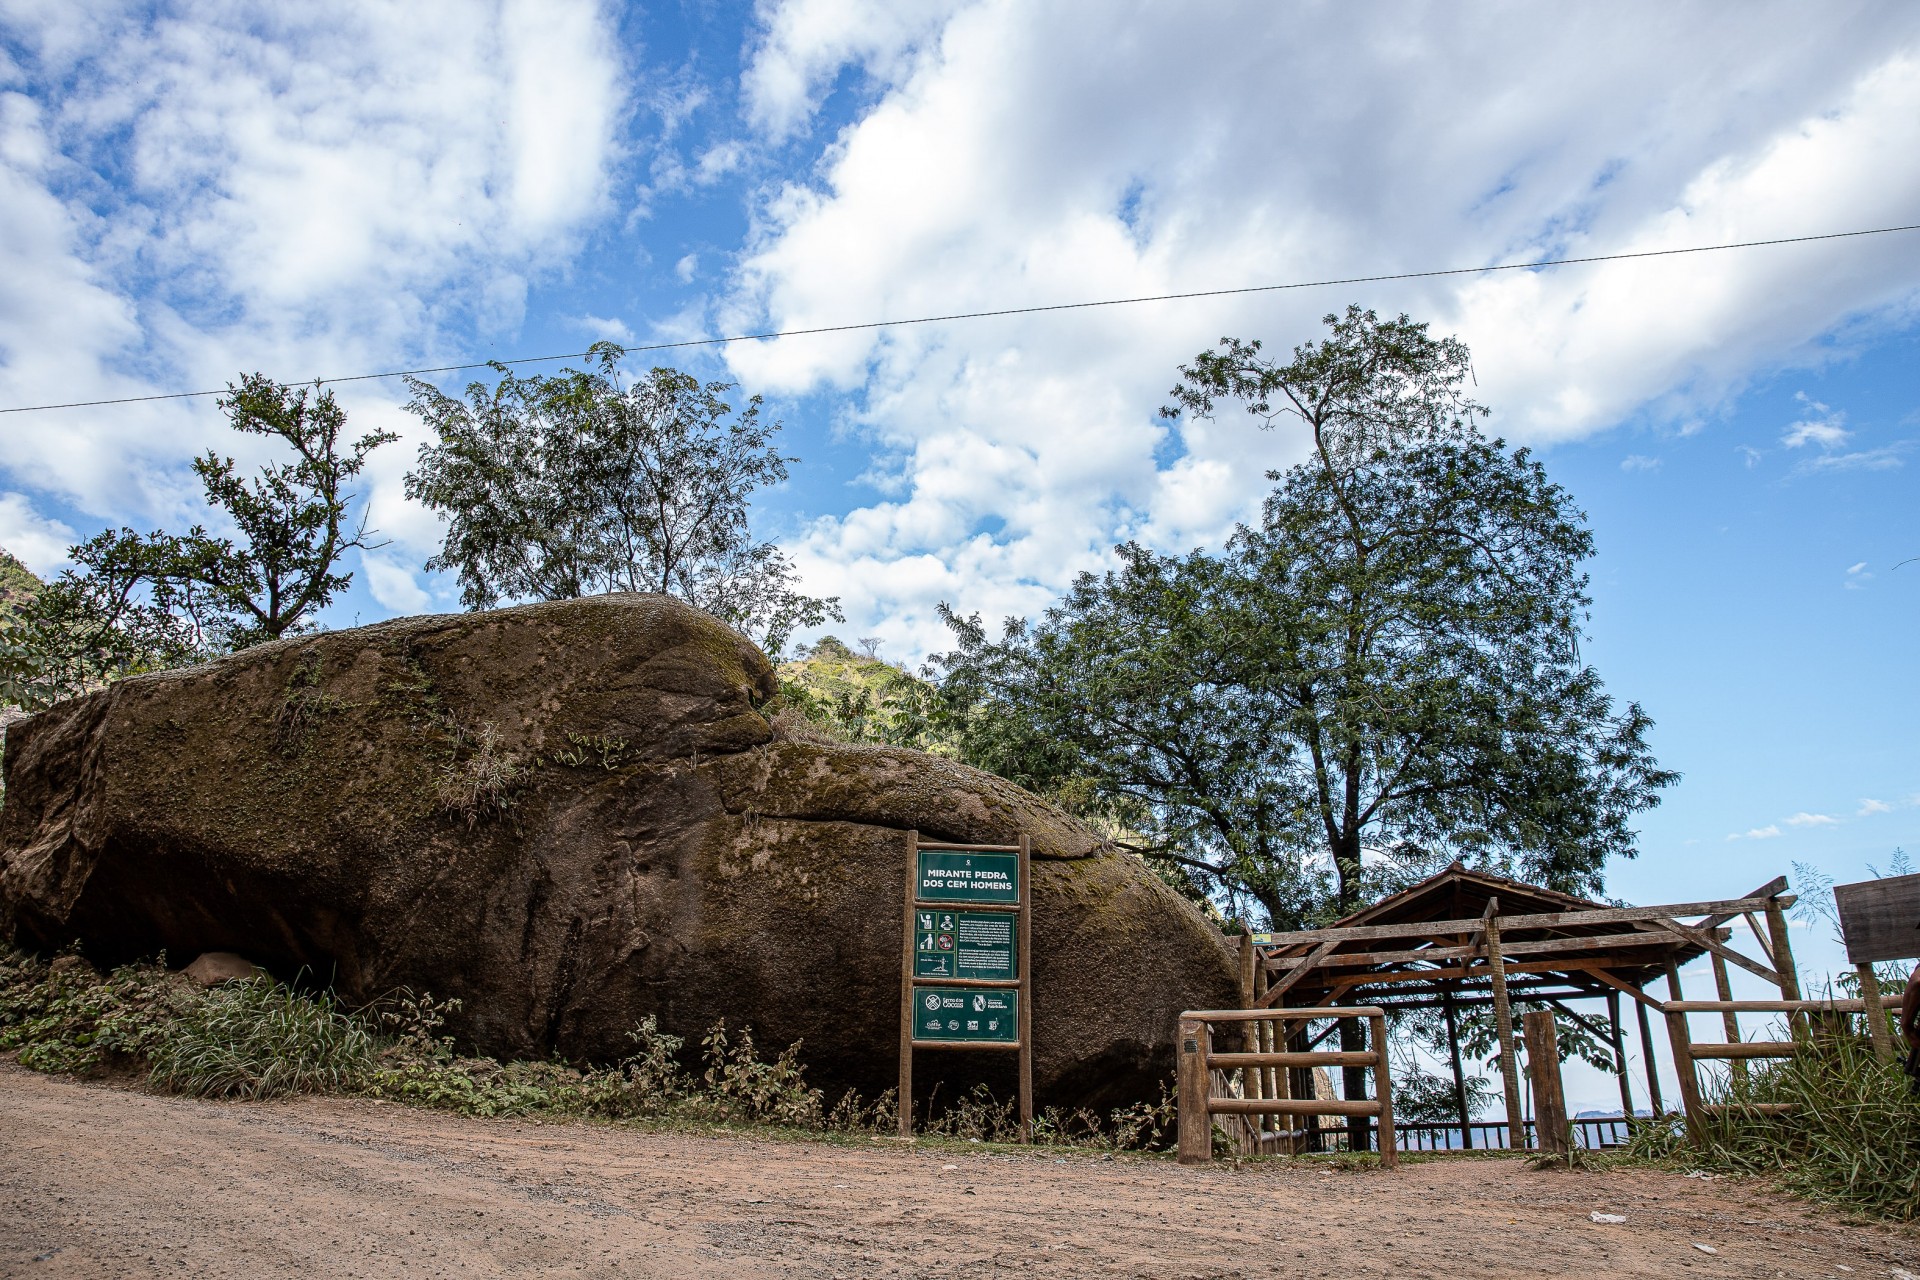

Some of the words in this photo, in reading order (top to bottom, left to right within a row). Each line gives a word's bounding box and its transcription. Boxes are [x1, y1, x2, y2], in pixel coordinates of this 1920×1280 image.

[928, 870, 972, 878] MIRANTE
[974, 871, 1008, 880] PEDRA
[923, 880, 944, 888] DOS
[946, 880, 968, 888] CEM
[970, 881, 1012, 890] HOMENS
